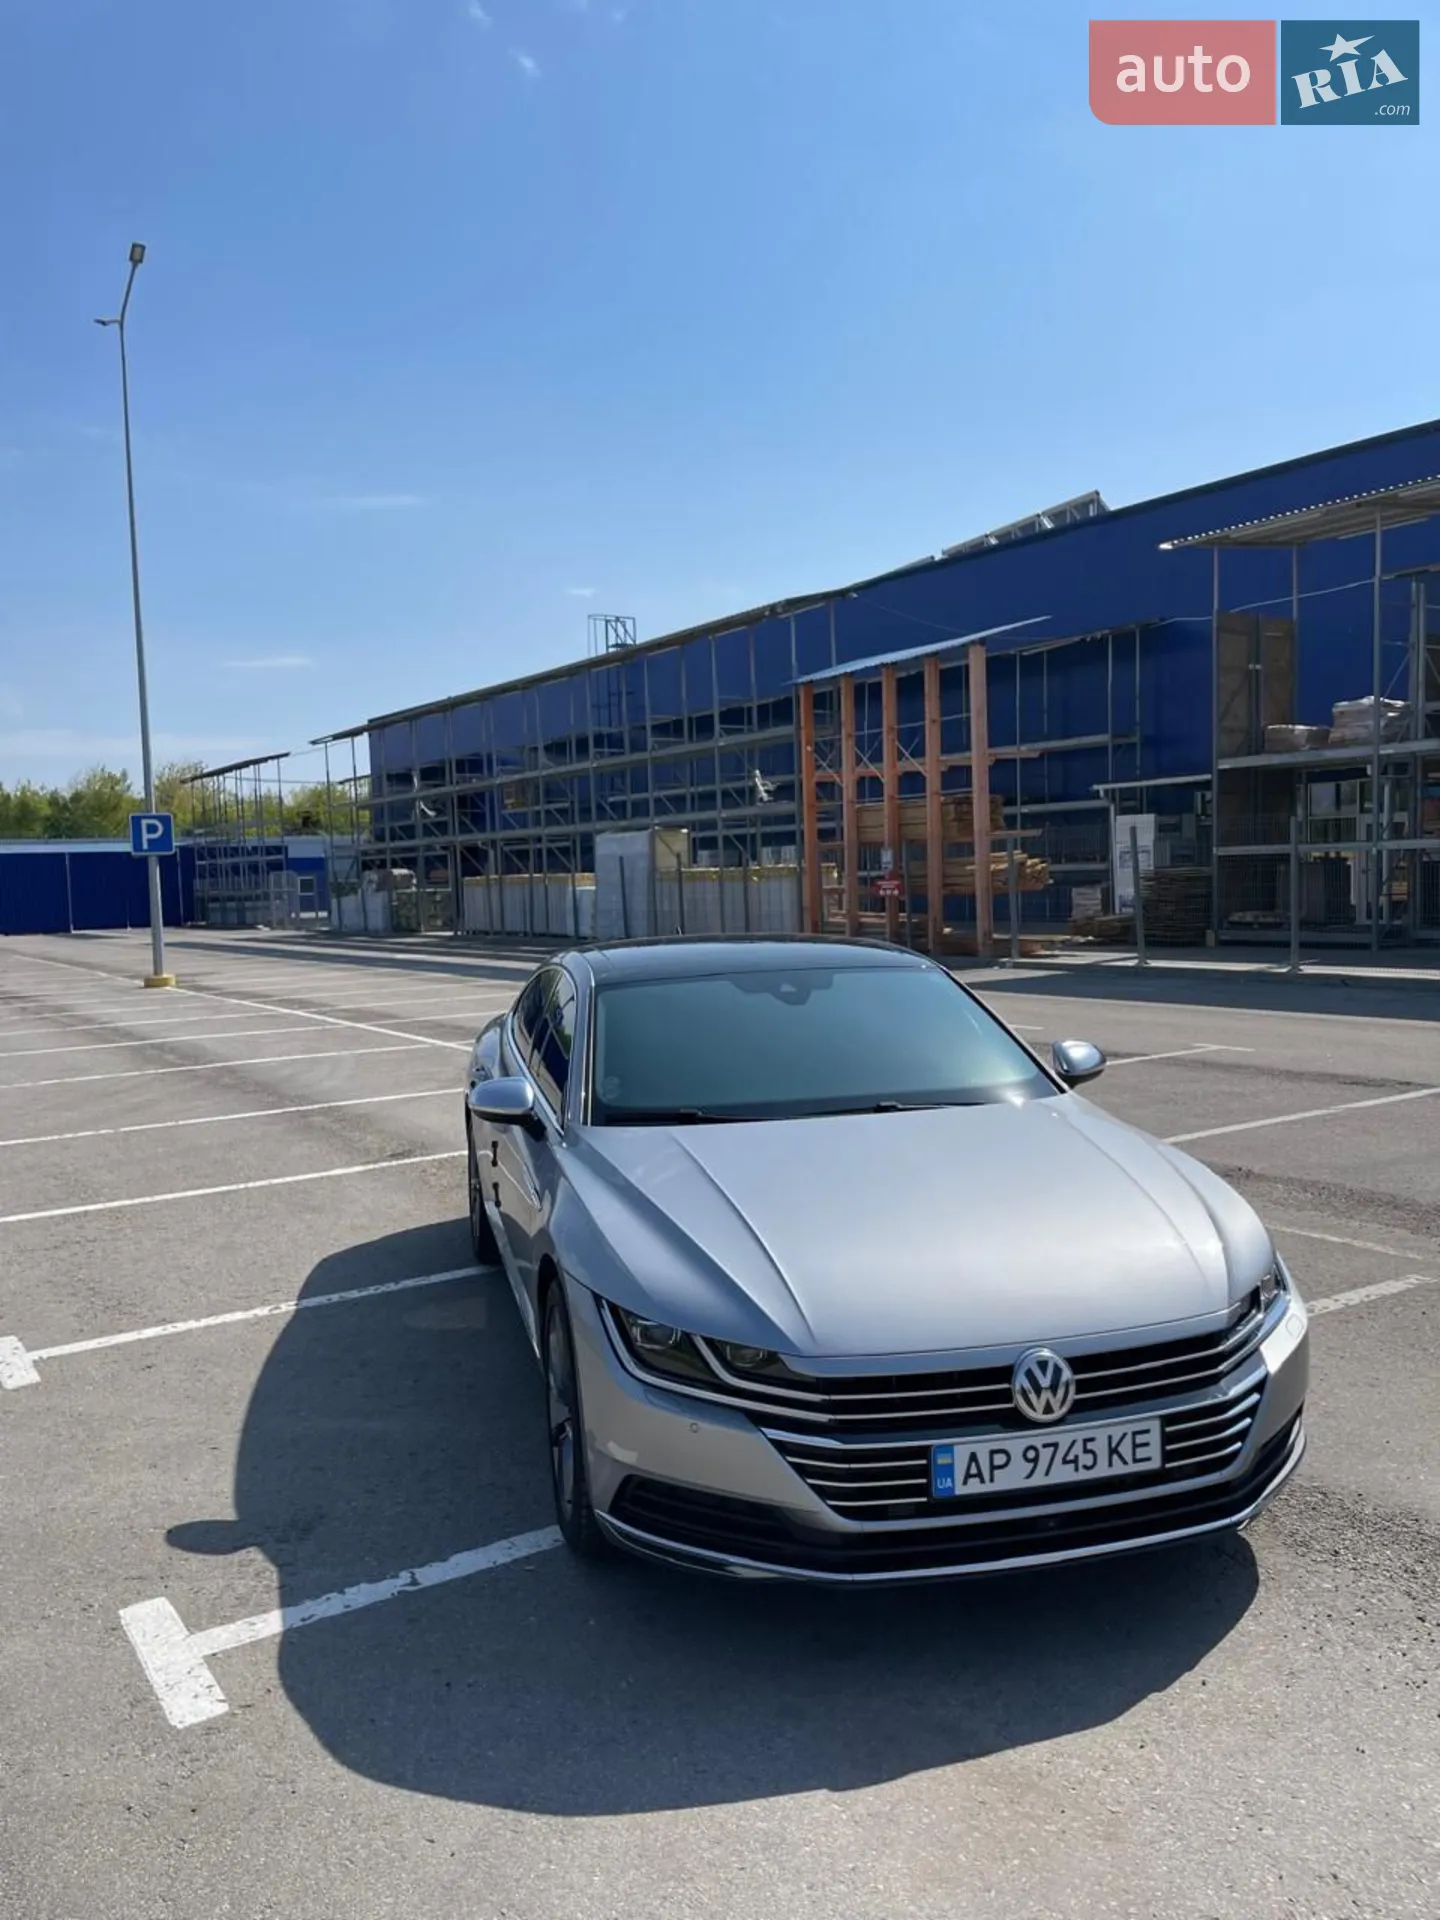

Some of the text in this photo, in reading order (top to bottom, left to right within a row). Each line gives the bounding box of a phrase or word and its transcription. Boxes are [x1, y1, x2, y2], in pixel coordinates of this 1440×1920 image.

[140, 818, 164, 850] P
[1014, 1348, 1075, 1422] VW
[961, 1429, 1152, 1486] AP 9745 KE
[936, 1477, 953, 1490] UA
